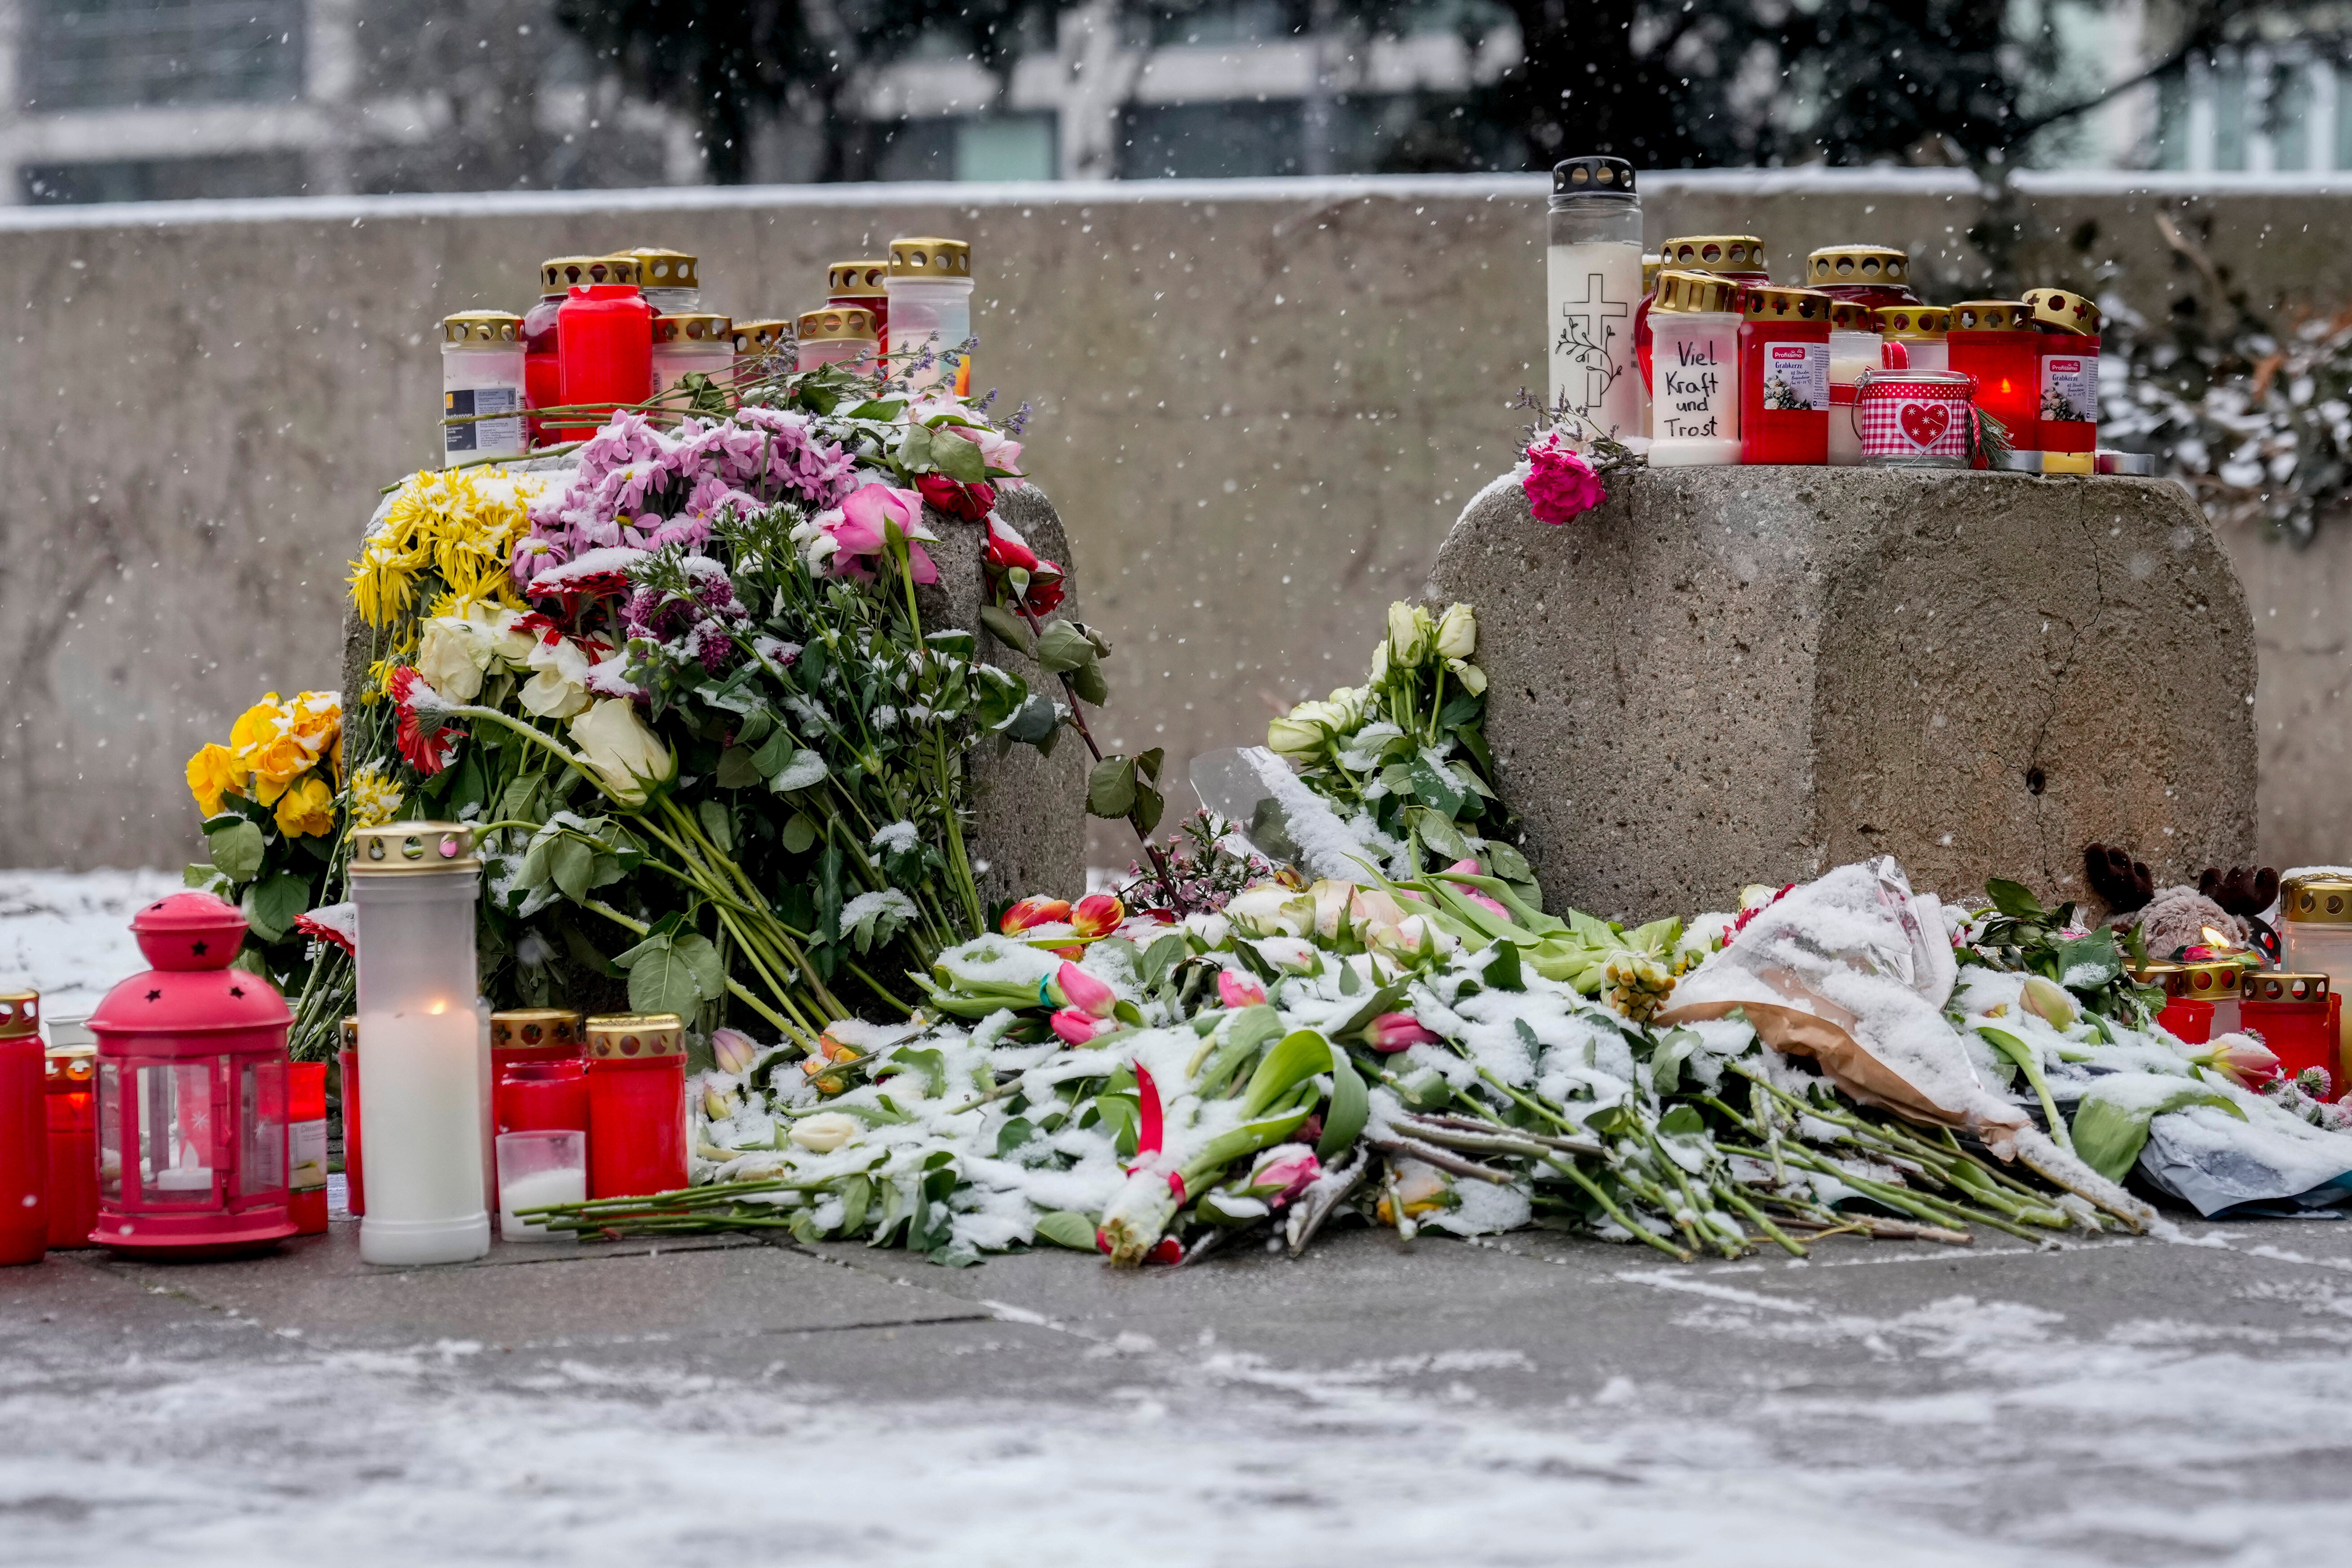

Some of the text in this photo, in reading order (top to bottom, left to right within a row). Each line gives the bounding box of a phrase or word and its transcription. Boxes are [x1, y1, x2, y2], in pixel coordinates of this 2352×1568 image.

[1677, 340, 1717, 367] Viel
[1665, 371, 1719, 397] Kraft
[1676, 397, 1709, 412] und
[1664, 416, 1718, 437] Trost
